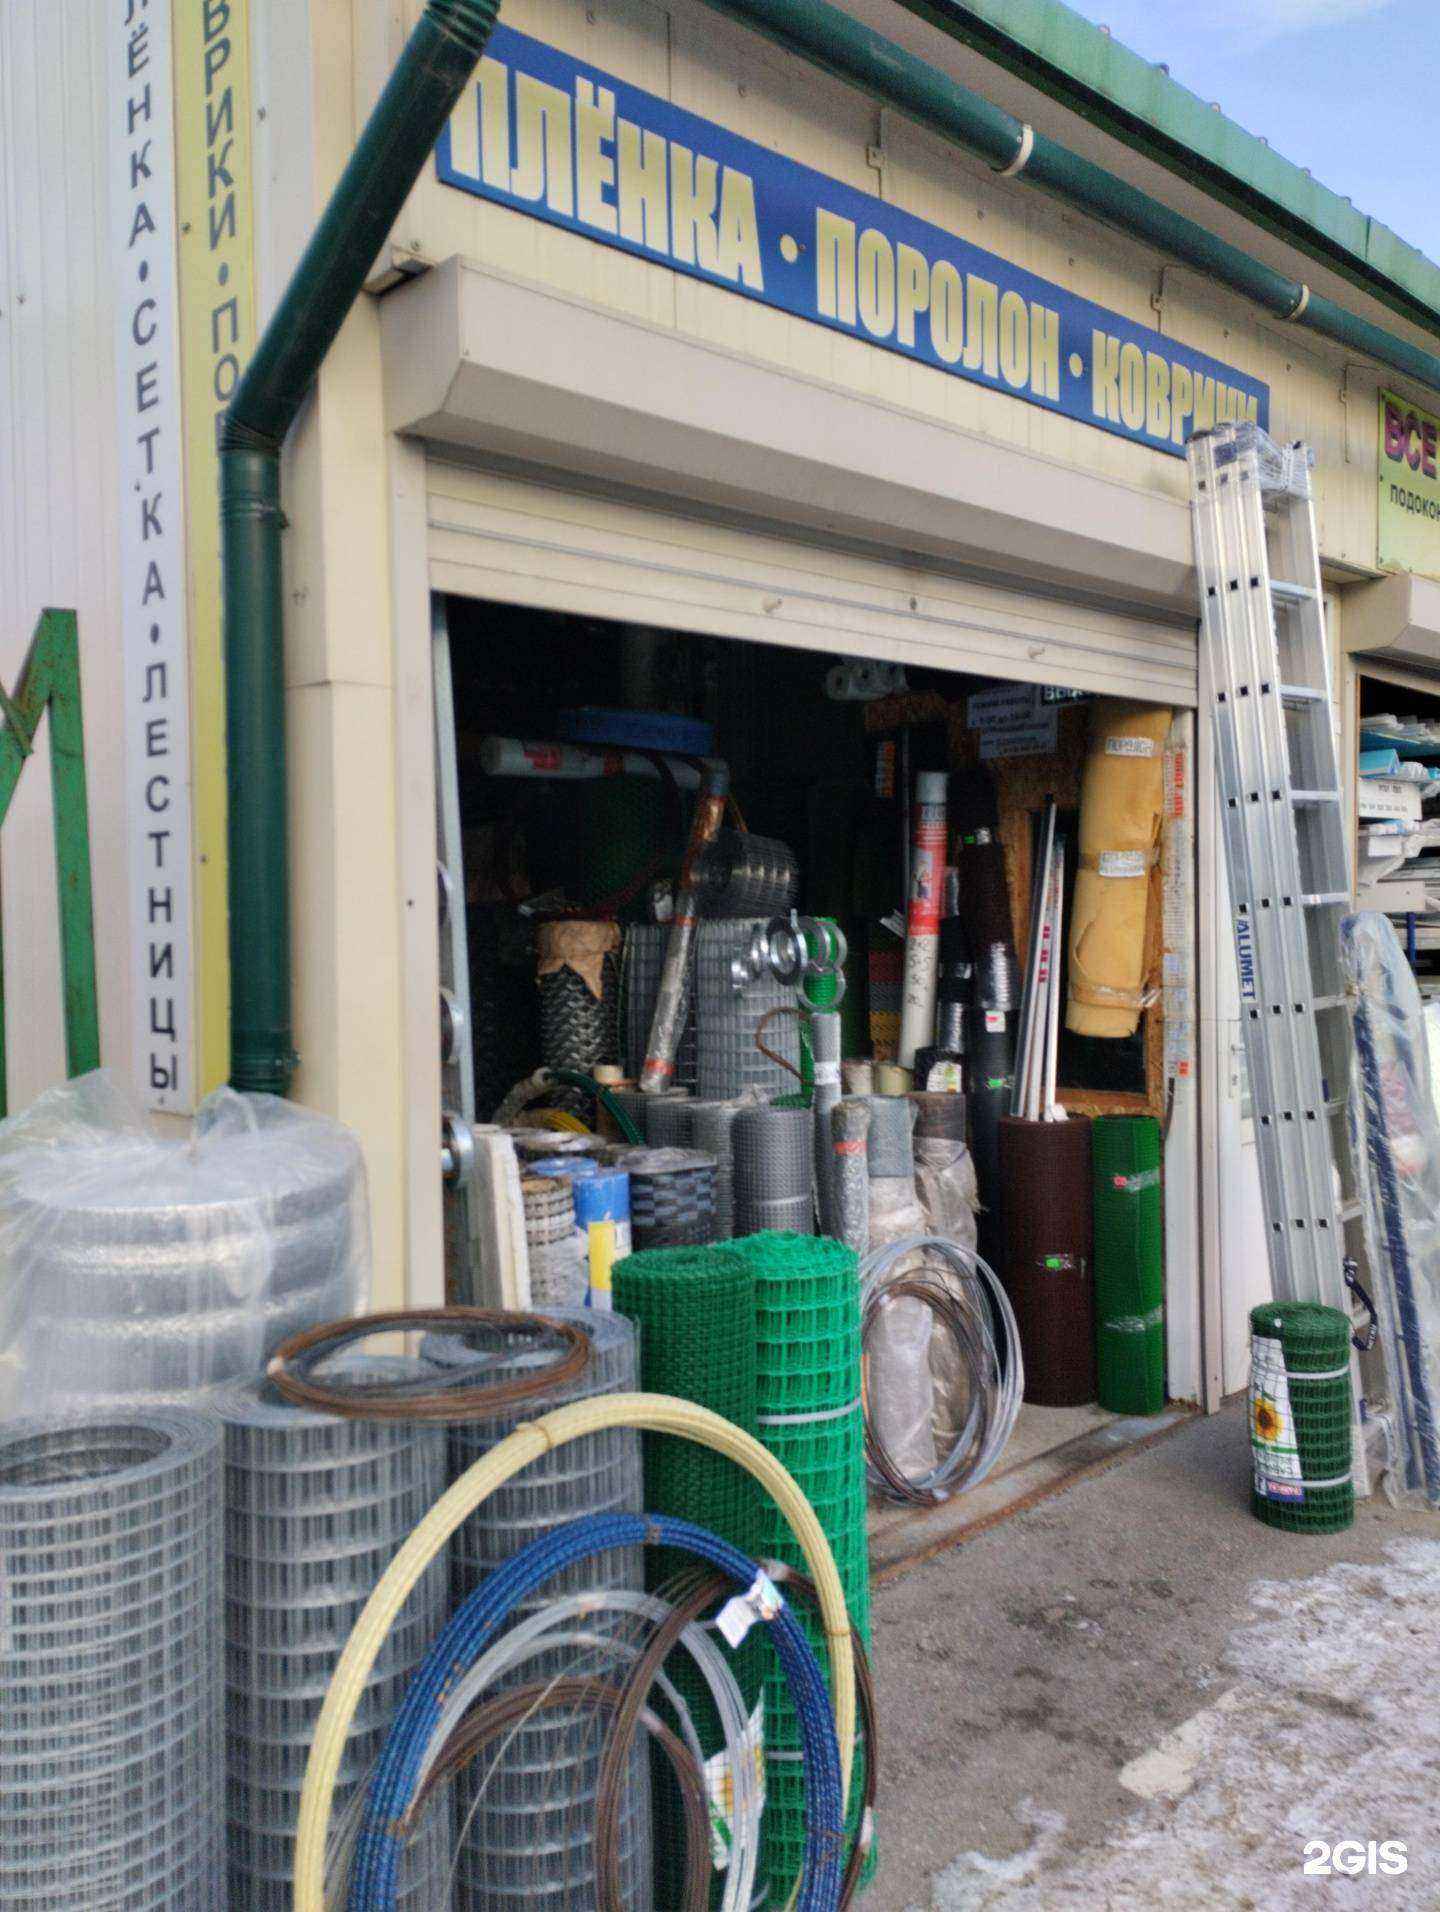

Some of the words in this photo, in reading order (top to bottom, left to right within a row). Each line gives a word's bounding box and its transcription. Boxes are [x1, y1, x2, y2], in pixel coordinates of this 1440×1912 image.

[449, 54, 764, 293] ПЛЁНКА
[816, 207, 1060, 402] ПОРОЛОН
[131, 299, 167, 606] СЕТКА
[212, 296, 241, 456] ПО
[1384, 401, 1437, 480] ВСЕ
[142, 662, 178, 1091] ЛЕСТНИЦЫ
[1236, 919, 1256, 999] ALUMET
